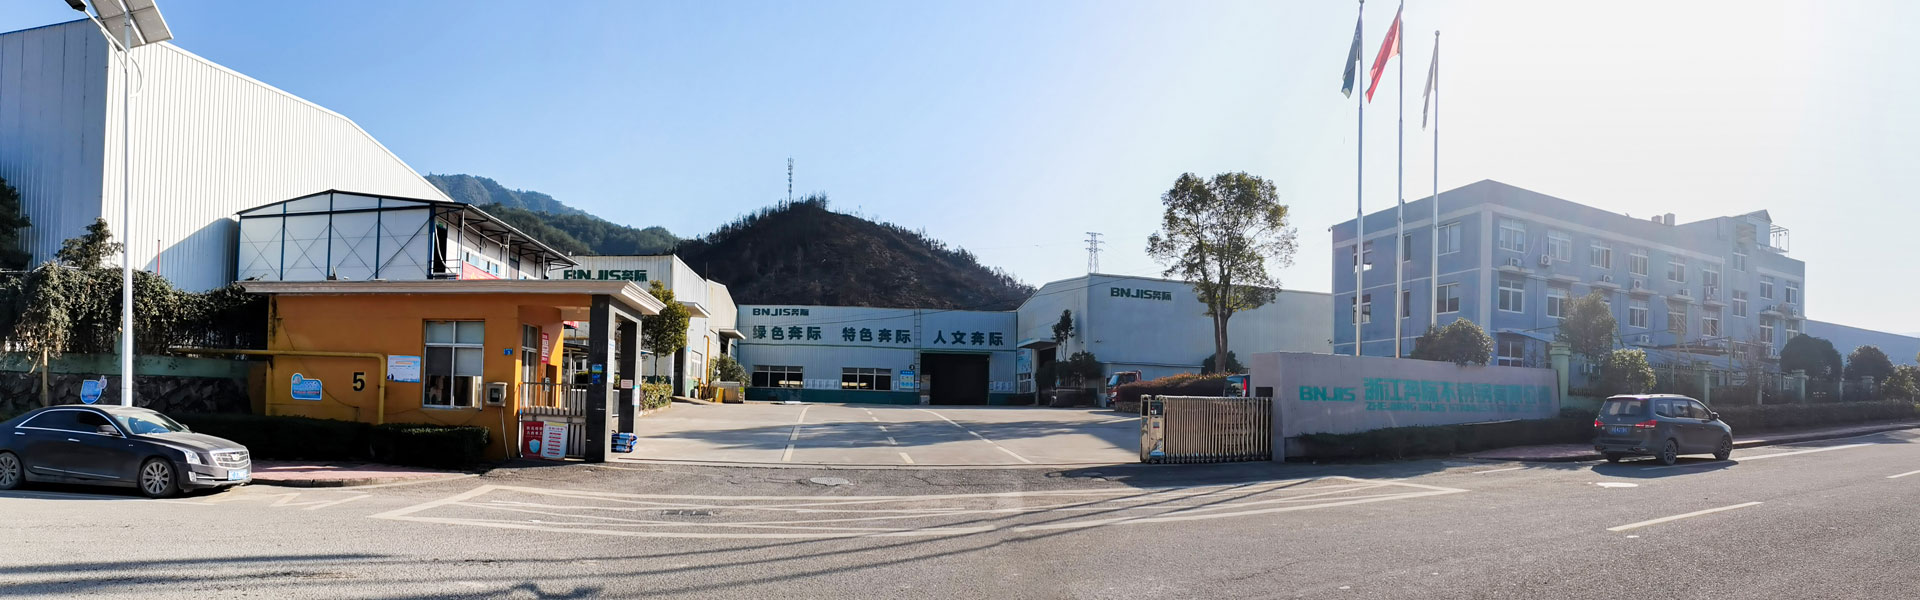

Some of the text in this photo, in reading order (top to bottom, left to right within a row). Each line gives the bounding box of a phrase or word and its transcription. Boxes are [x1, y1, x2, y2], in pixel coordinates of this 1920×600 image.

[752, 325, 1004, 346] 绿色奔际 特色奔际 人文奔际
[352, 371, 365, 392] 5
[1299, 385, 1356, 402] BNJIS
